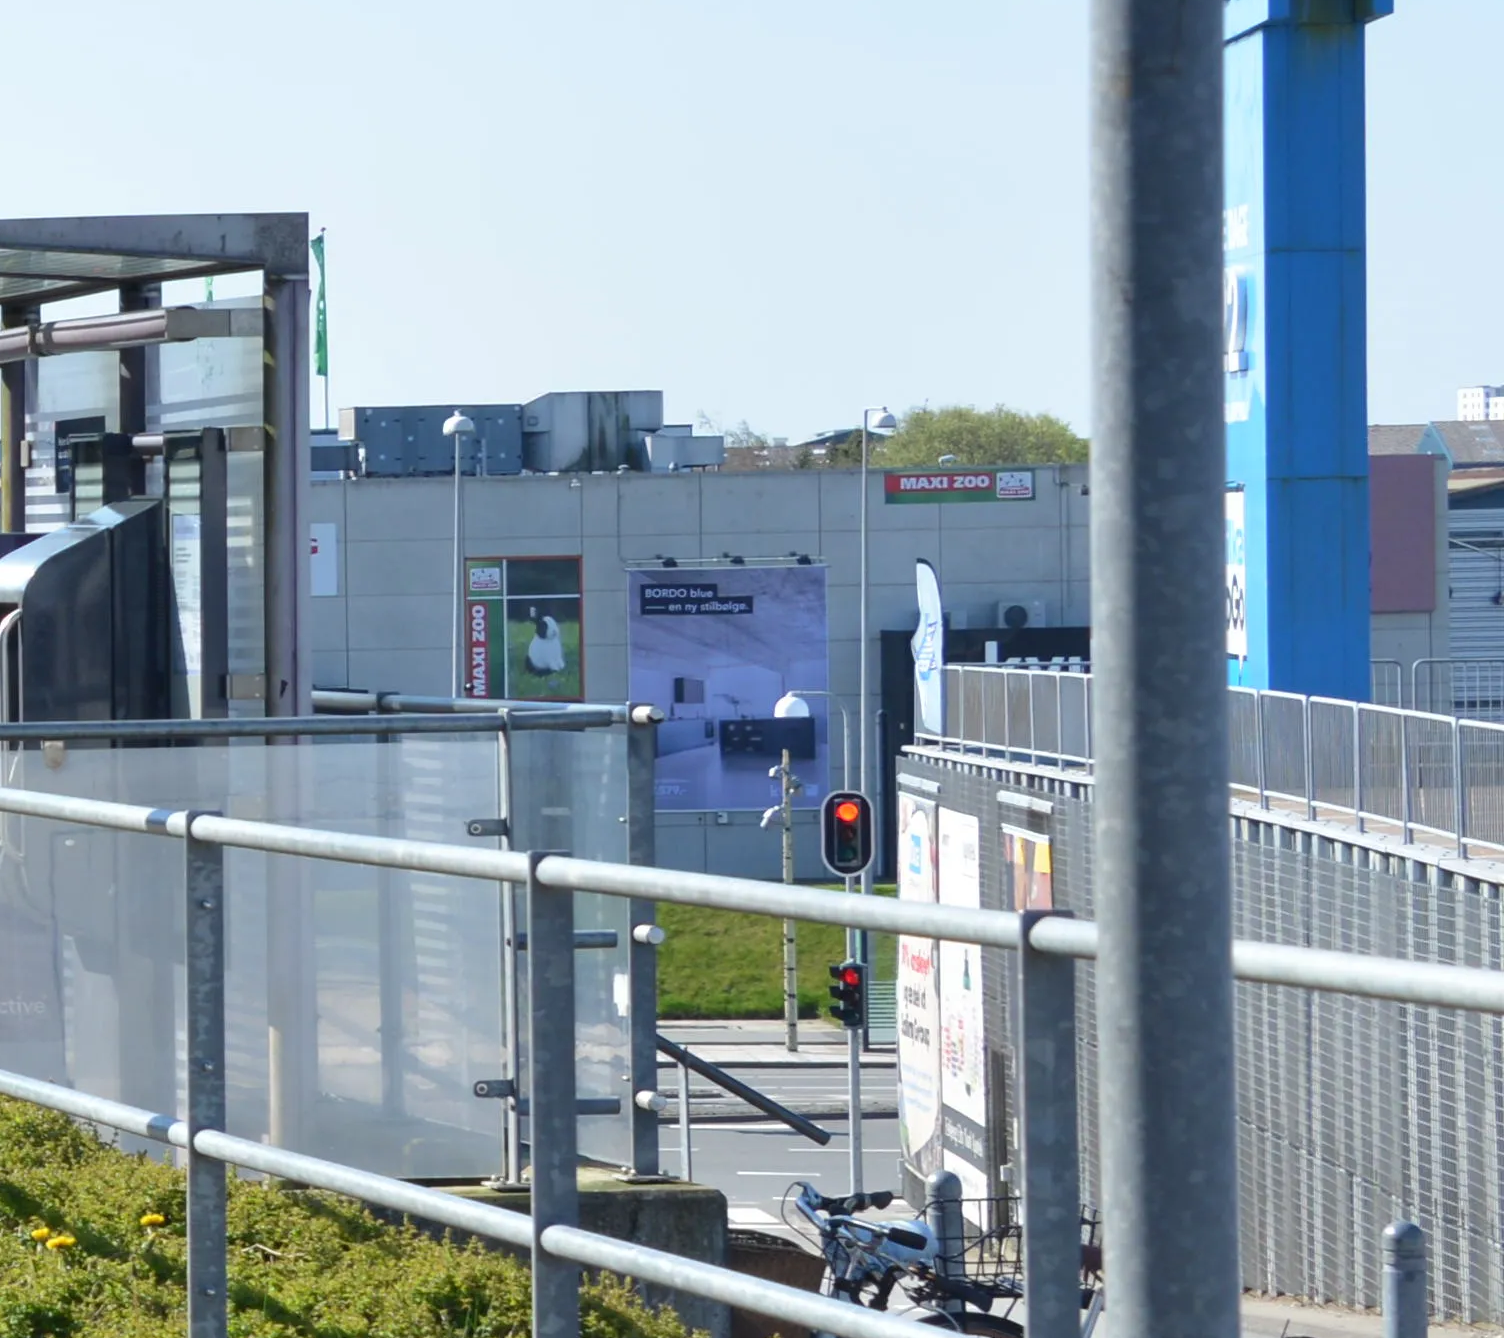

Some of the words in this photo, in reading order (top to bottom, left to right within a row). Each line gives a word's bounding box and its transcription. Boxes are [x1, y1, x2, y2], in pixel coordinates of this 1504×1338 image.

[900, 477, 948, 490] MAXI
[953, 475, 990, 488] ZOO
[645, 588, 687, 598] BORDO
[690, 588, 714, 598] blue
[685, 603, 697, 613] ny
[472, 604, 486, 642] ZOO
[472, 647, 486, 696] MAXI
